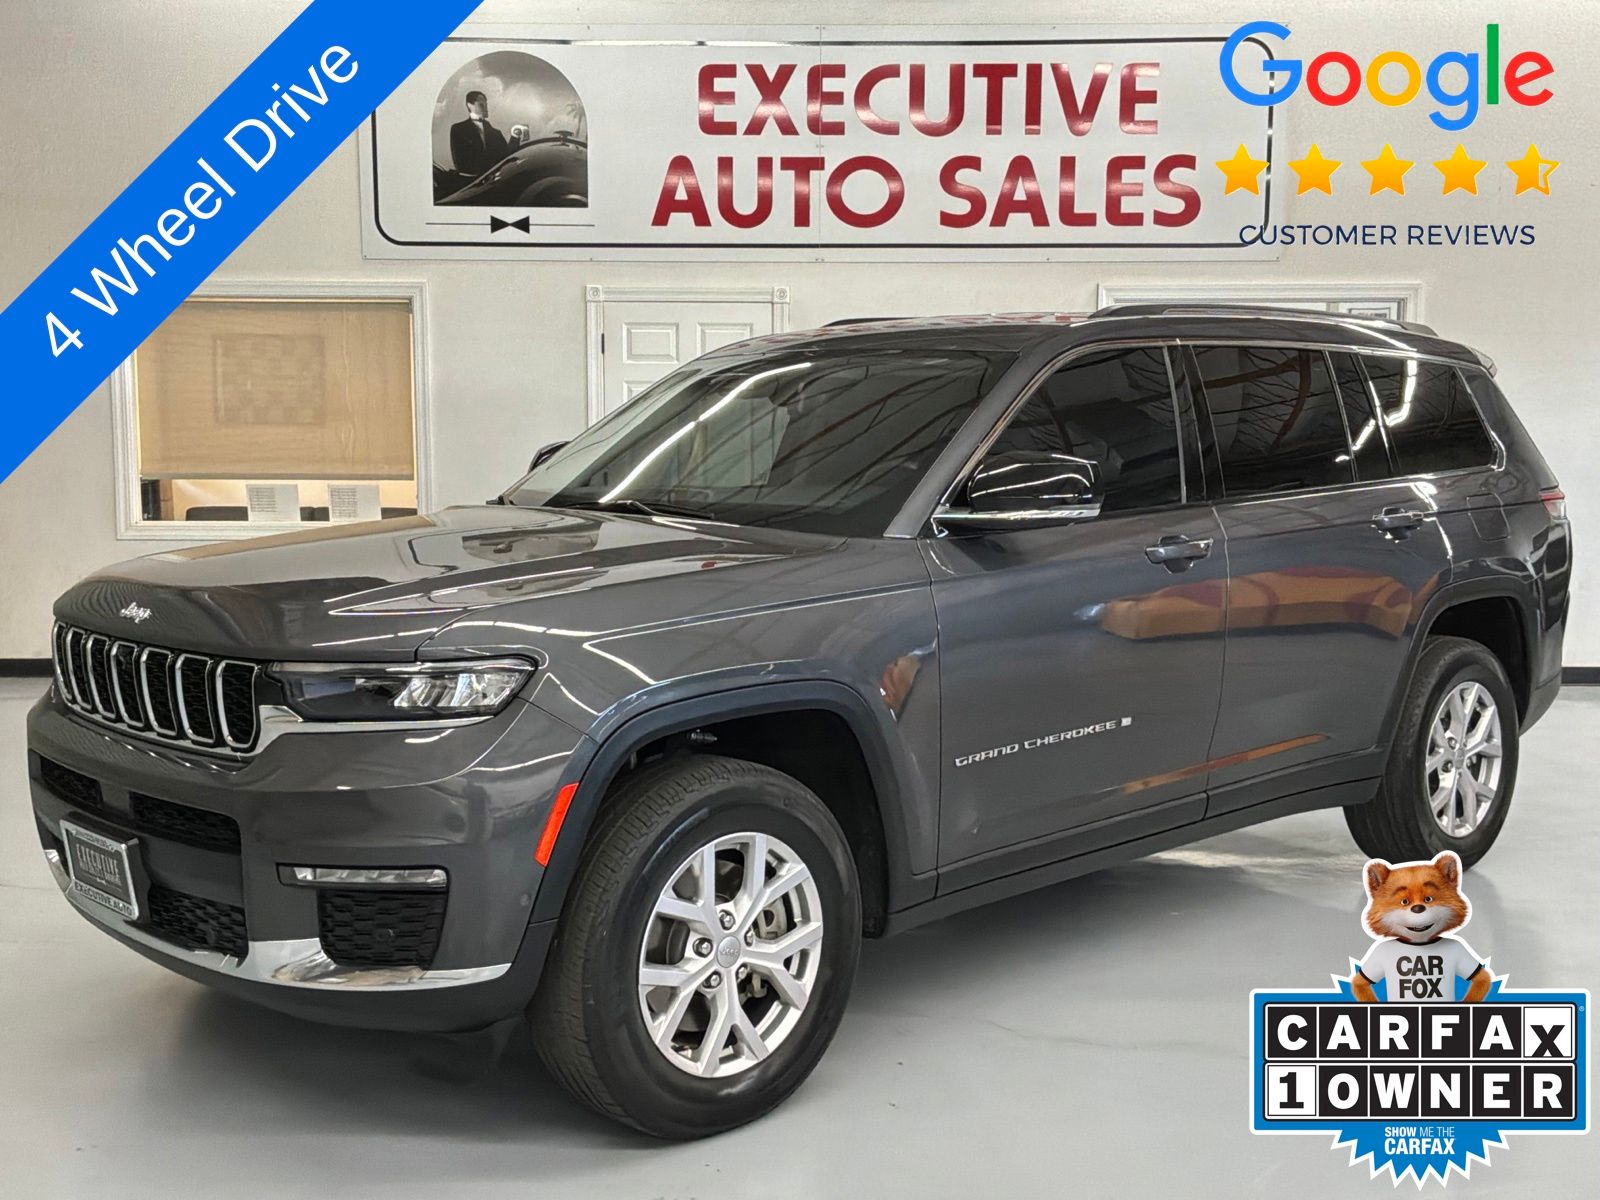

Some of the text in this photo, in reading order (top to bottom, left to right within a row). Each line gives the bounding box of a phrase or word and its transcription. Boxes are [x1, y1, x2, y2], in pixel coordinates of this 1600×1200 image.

[698, 62, 1160, 137] EXECUTIVE
[651, 154, 1201, 229] AUTO SALES
[120, 601, 152, 624] Jeep
[955, 720, 1117, 767] GRAND CHEROKEE
[75, 881, 113, 906] EXECUTIVE
